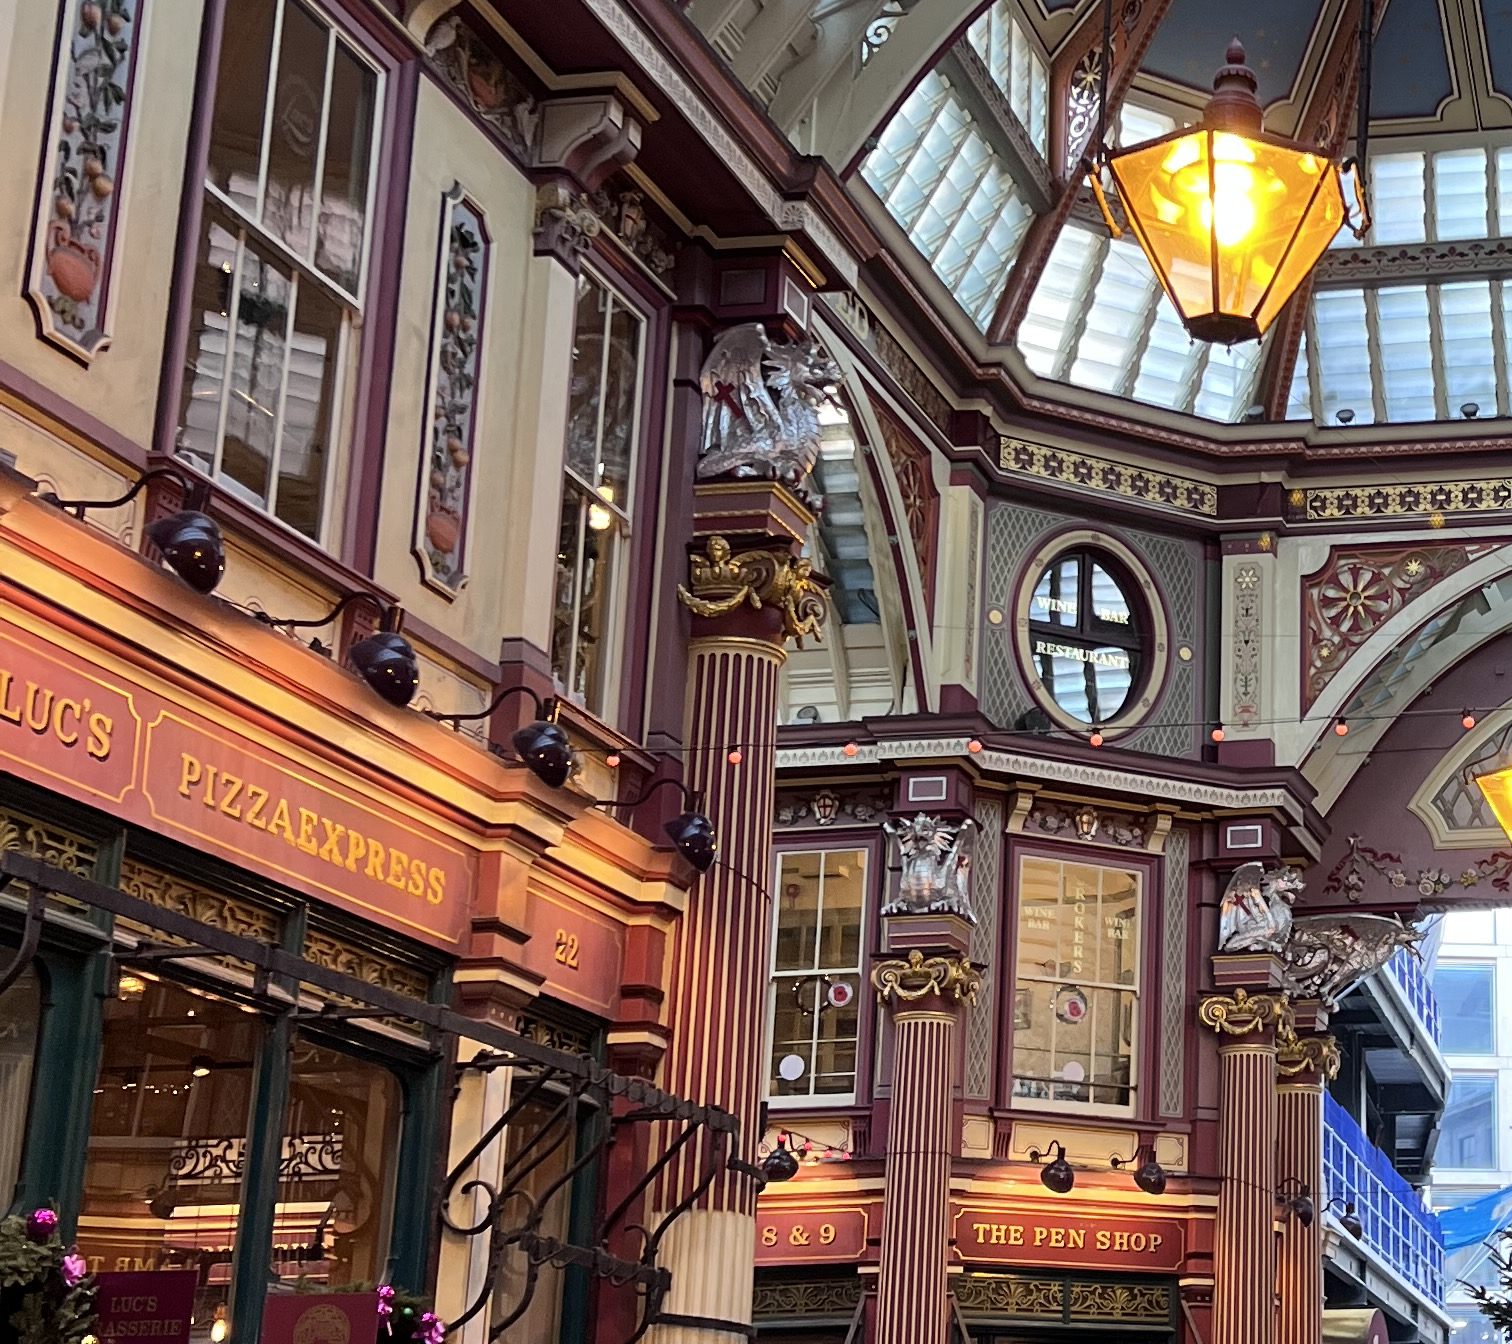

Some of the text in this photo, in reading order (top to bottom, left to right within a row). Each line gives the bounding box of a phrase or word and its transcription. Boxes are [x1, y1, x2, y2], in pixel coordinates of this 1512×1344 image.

[0, 668, 114, 759] LUC'S
[179, 753, 447, 906] PIZZAEXPRESS
[555, 928, 580, 969] 22
[762, 1223, 836, 1247] 8 & 9
[973, 1223, 1162, 1252] THE PEN SHOP
[97, 1318, 183, 1338] ASSERIE
